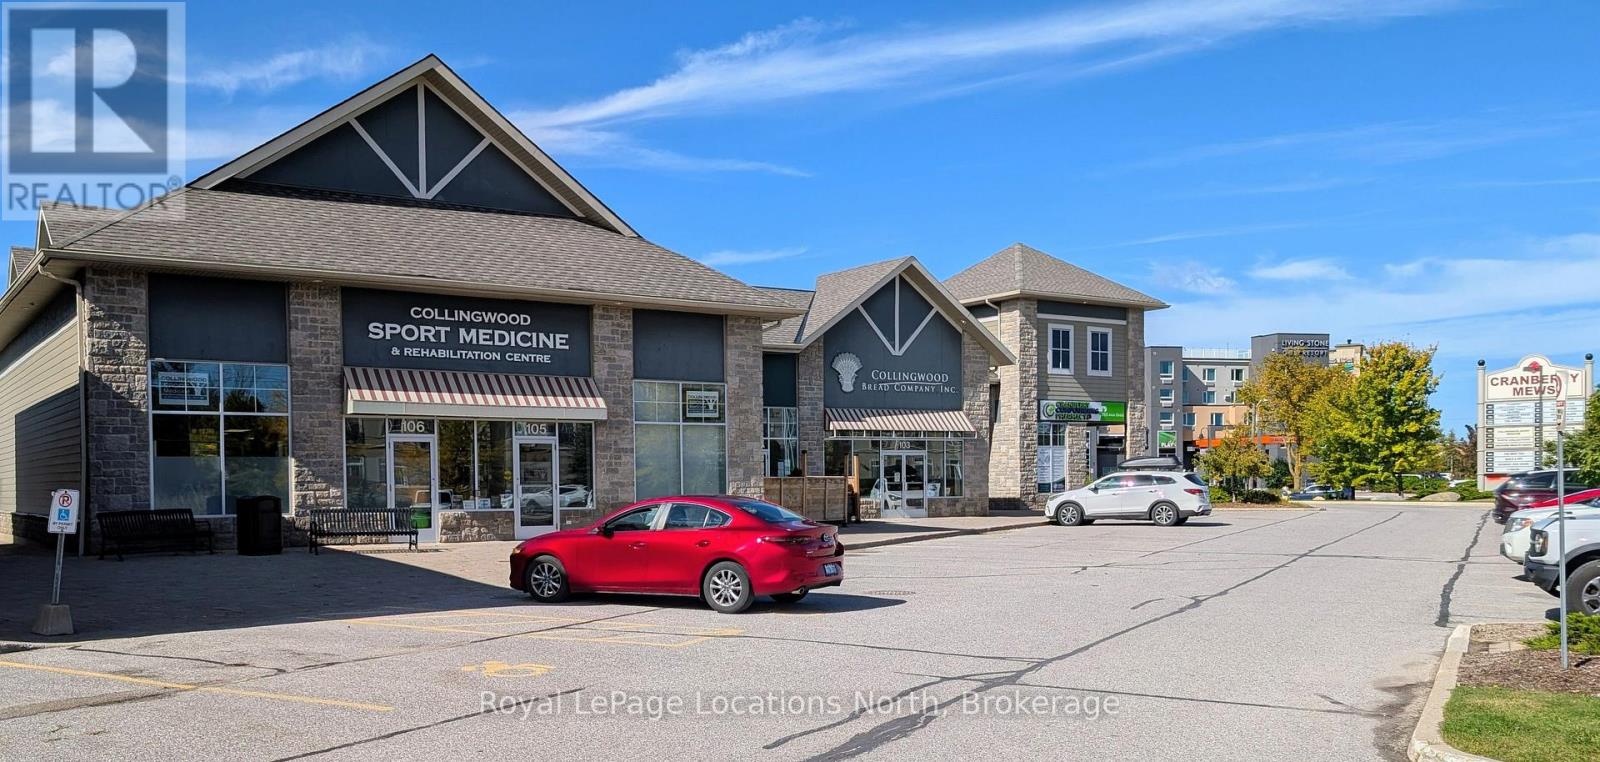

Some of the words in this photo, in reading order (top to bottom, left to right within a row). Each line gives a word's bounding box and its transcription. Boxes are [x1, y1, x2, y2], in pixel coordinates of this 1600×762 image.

[410, 306, 531, 326] COLLINGWOOD
[368, 321, 451, 344] SPORT
[459, 327, 570, 350] MEDICINE
[1282, 339, 1304, 347] LIVING
[1307, 339, 1329, 347] STONE
[391, 347, 400, 356] &
[404, 347, 501, 361] REHABILITATION
[505, 352, 551, 363] CENTRE
[871, 369, 949, 383] COLLINGWOOD
[1490, 373, 1579, 386] CRANBERY
[861, 382, 890, 392] BREAD
[894, 384, 936, 393] COMPANY
[1512, 385, 1556, 396] MEWS
[402, 420, 425, 433] 106
[526, 423, 547, 434] 105
[899, 441, 911, 449] 103
